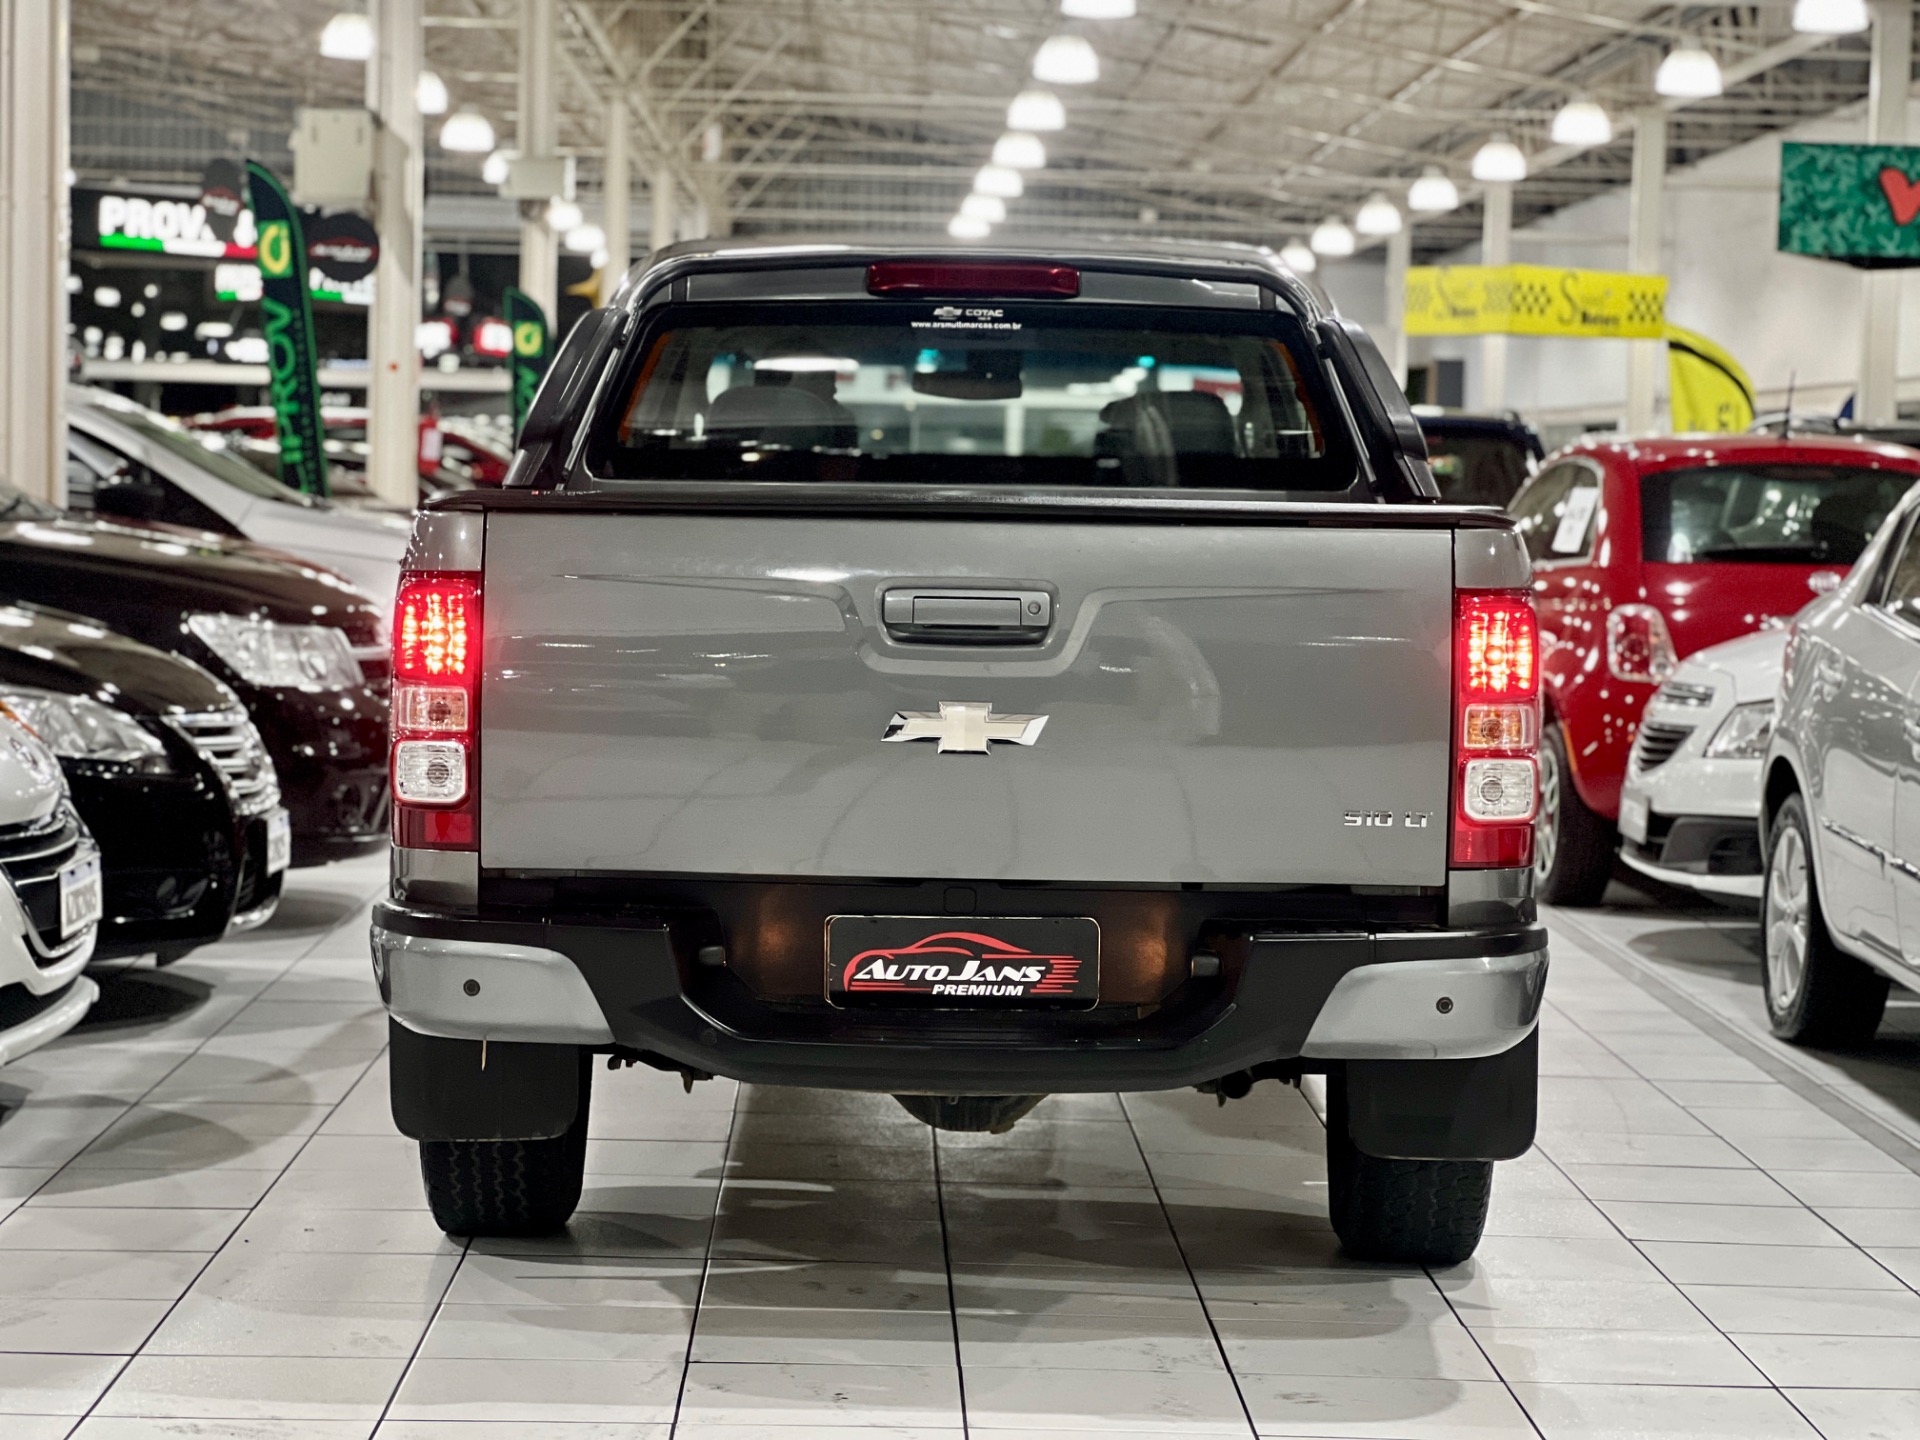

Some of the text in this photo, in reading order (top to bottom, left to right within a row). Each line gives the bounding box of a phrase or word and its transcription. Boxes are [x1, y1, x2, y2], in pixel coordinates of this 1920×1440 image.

[965, 309, 1004, 317] COTAC
[1344, 811, 1433, 828] S10 LT
[931, 983, 1024, 996] PREMIUM
